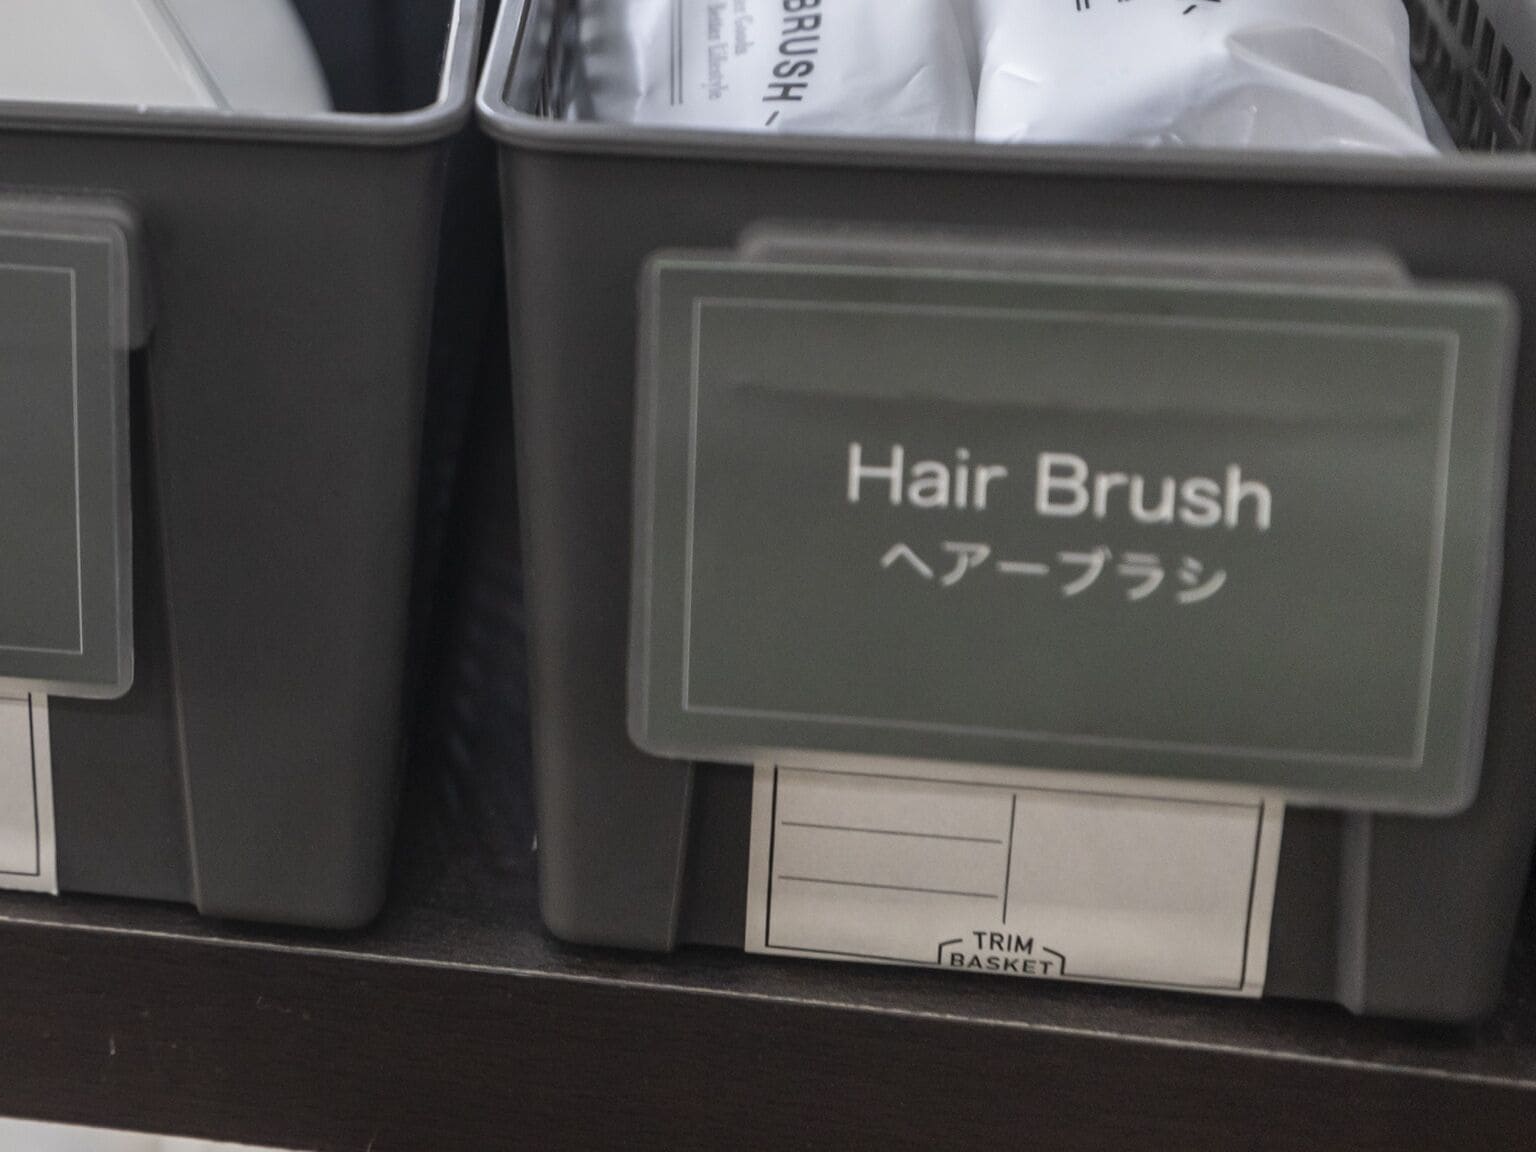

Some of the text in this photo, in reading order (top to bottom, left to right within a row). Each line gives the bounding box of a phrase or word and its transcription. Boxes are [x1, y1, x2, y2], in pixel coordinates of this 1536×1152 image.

[847, 442, 1272, 530] Hair Brush
[879, 541, 1228, 605] ヘアーブラシ
[950, 952, 1053, 975] BASKET
[972, 930, 1034, 955] TRIM
